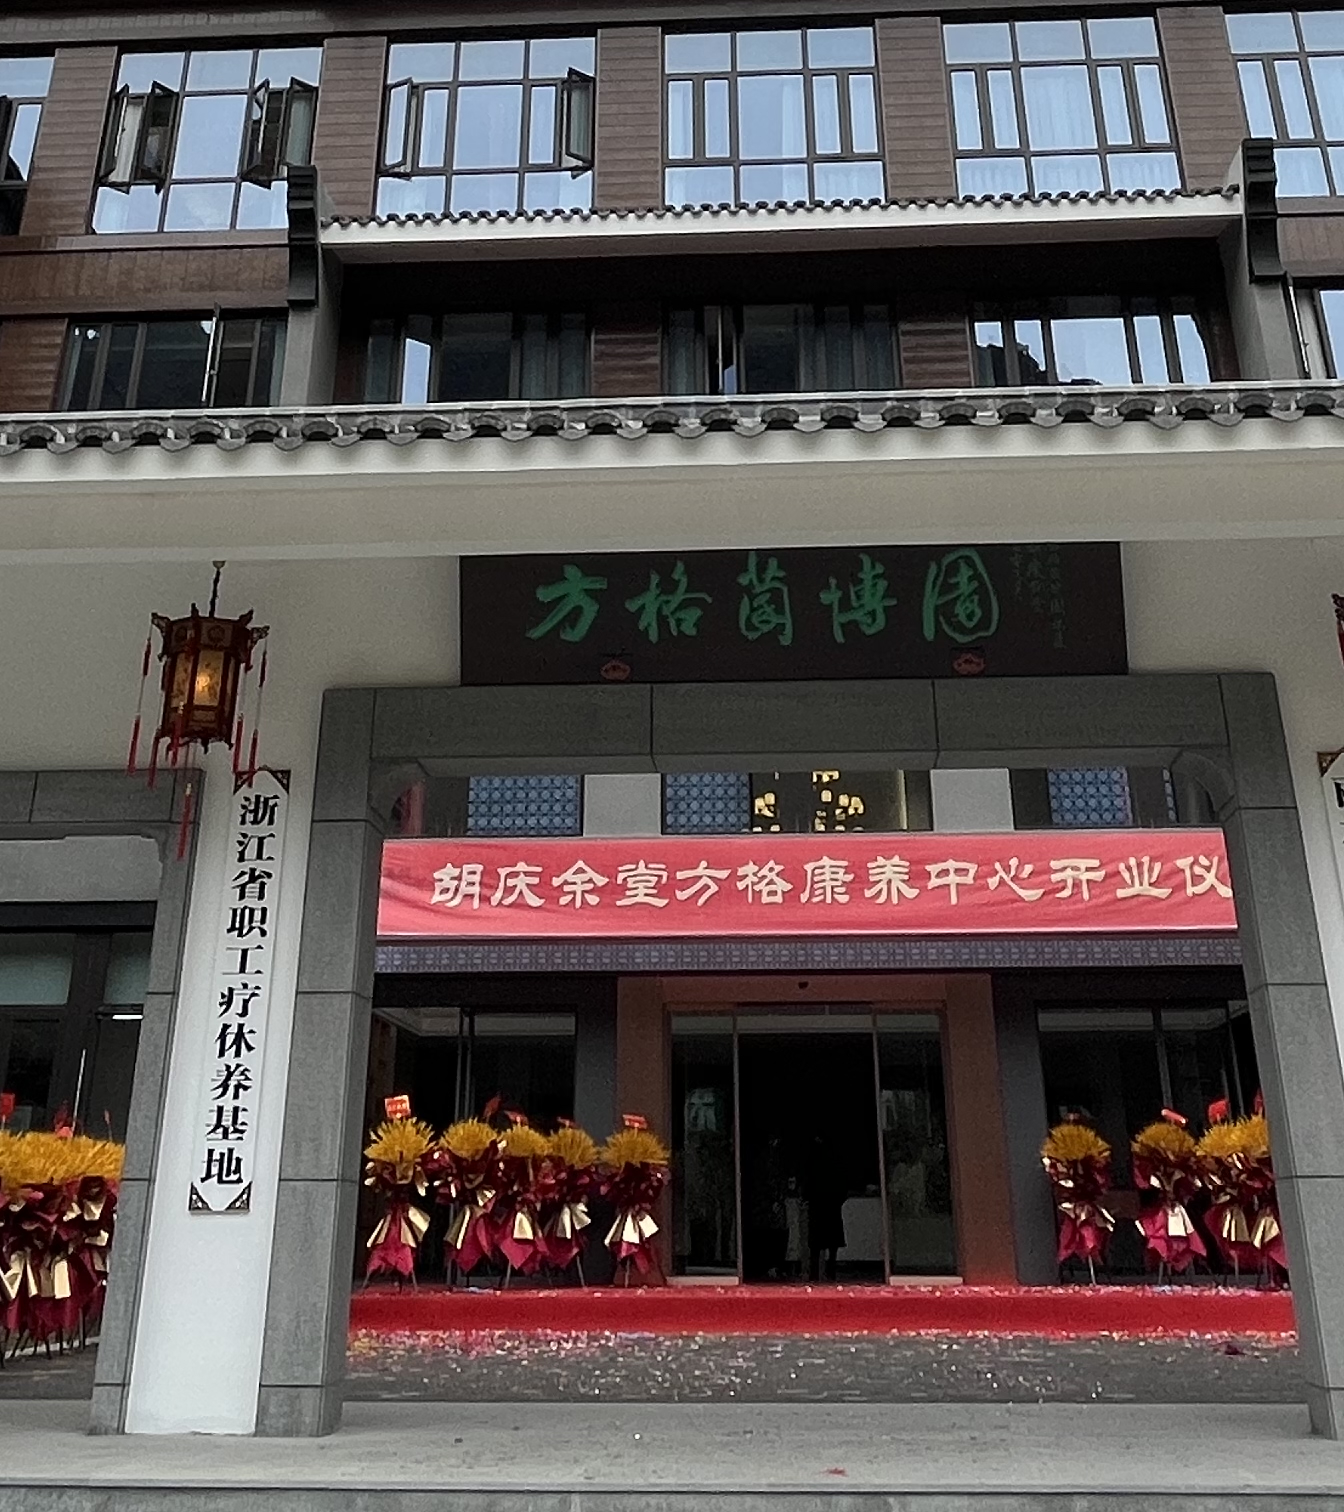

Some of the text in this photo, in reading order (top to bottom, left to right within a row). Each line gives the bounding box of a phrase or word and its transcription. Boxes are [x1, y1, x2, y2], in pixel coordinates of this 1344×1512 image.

[199, 793, 281, 1186] 浙江省职工疗休养基地
[430, 854, 1234, 910] 胡庆余堂方格康养中心开业仪
